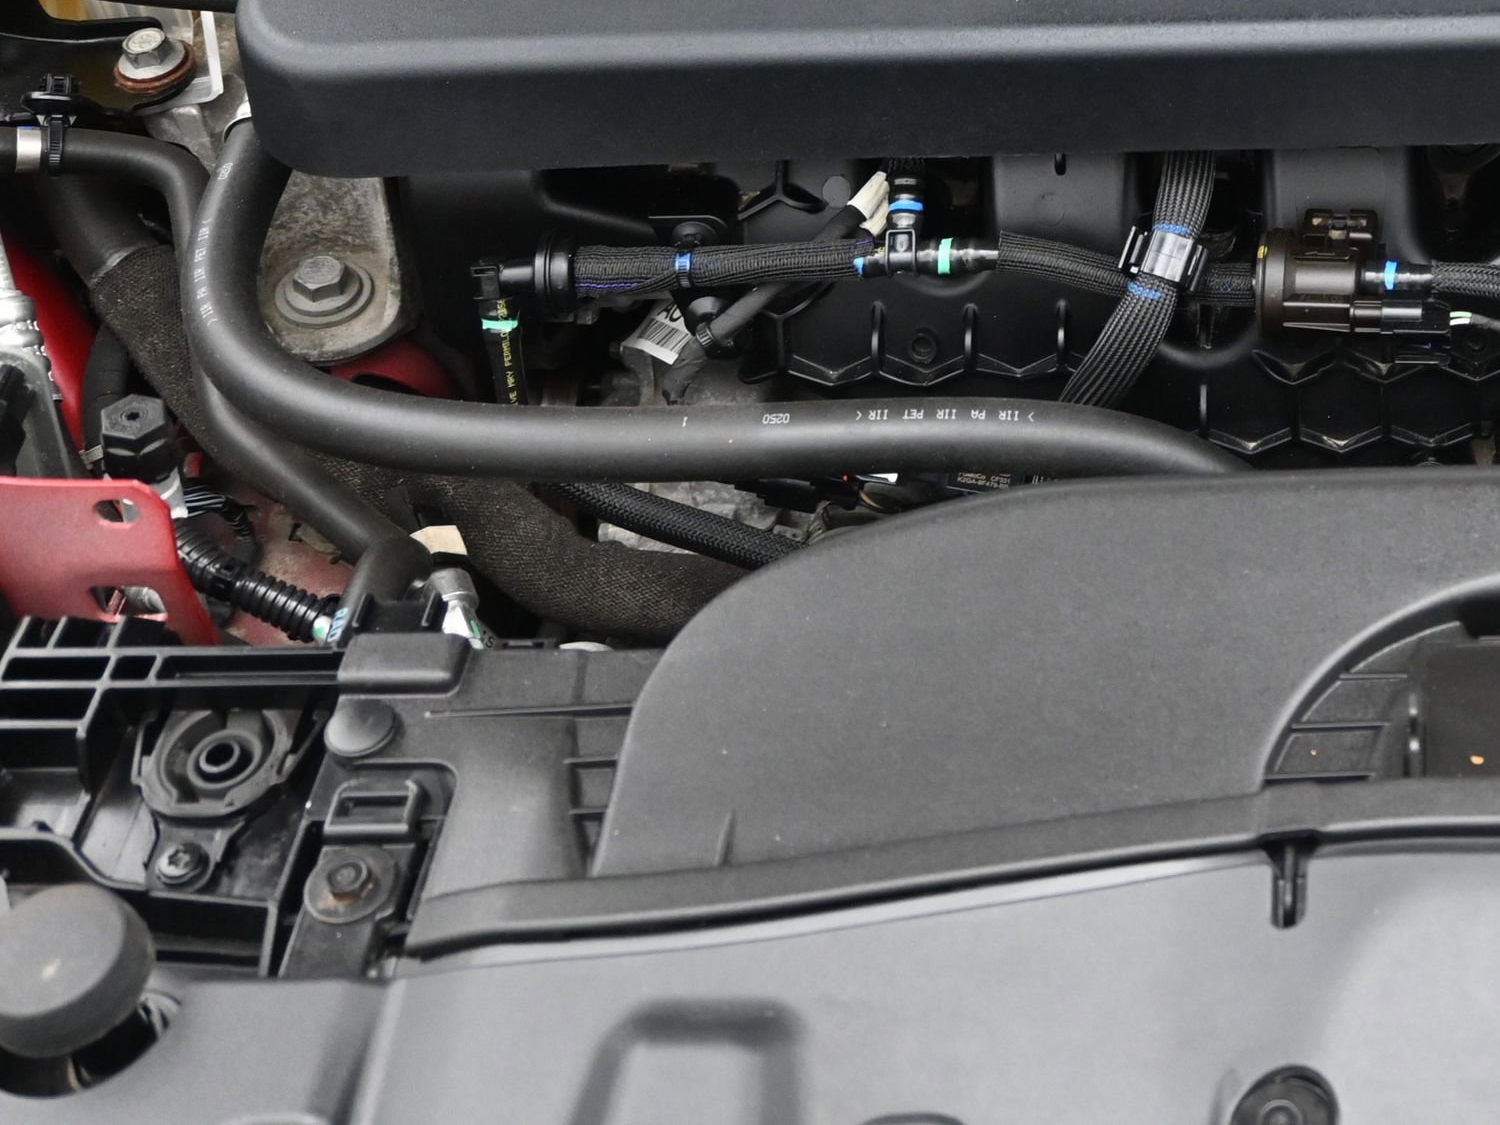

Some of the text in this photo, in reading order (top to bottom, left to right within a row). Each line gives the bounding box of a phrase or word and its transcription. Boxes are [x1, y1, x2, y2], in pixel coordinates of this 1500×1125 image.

[763, 413, 790, 425] 0250
[903, 408, 924, 420] PET
[971, 409, 986, 421] PA
